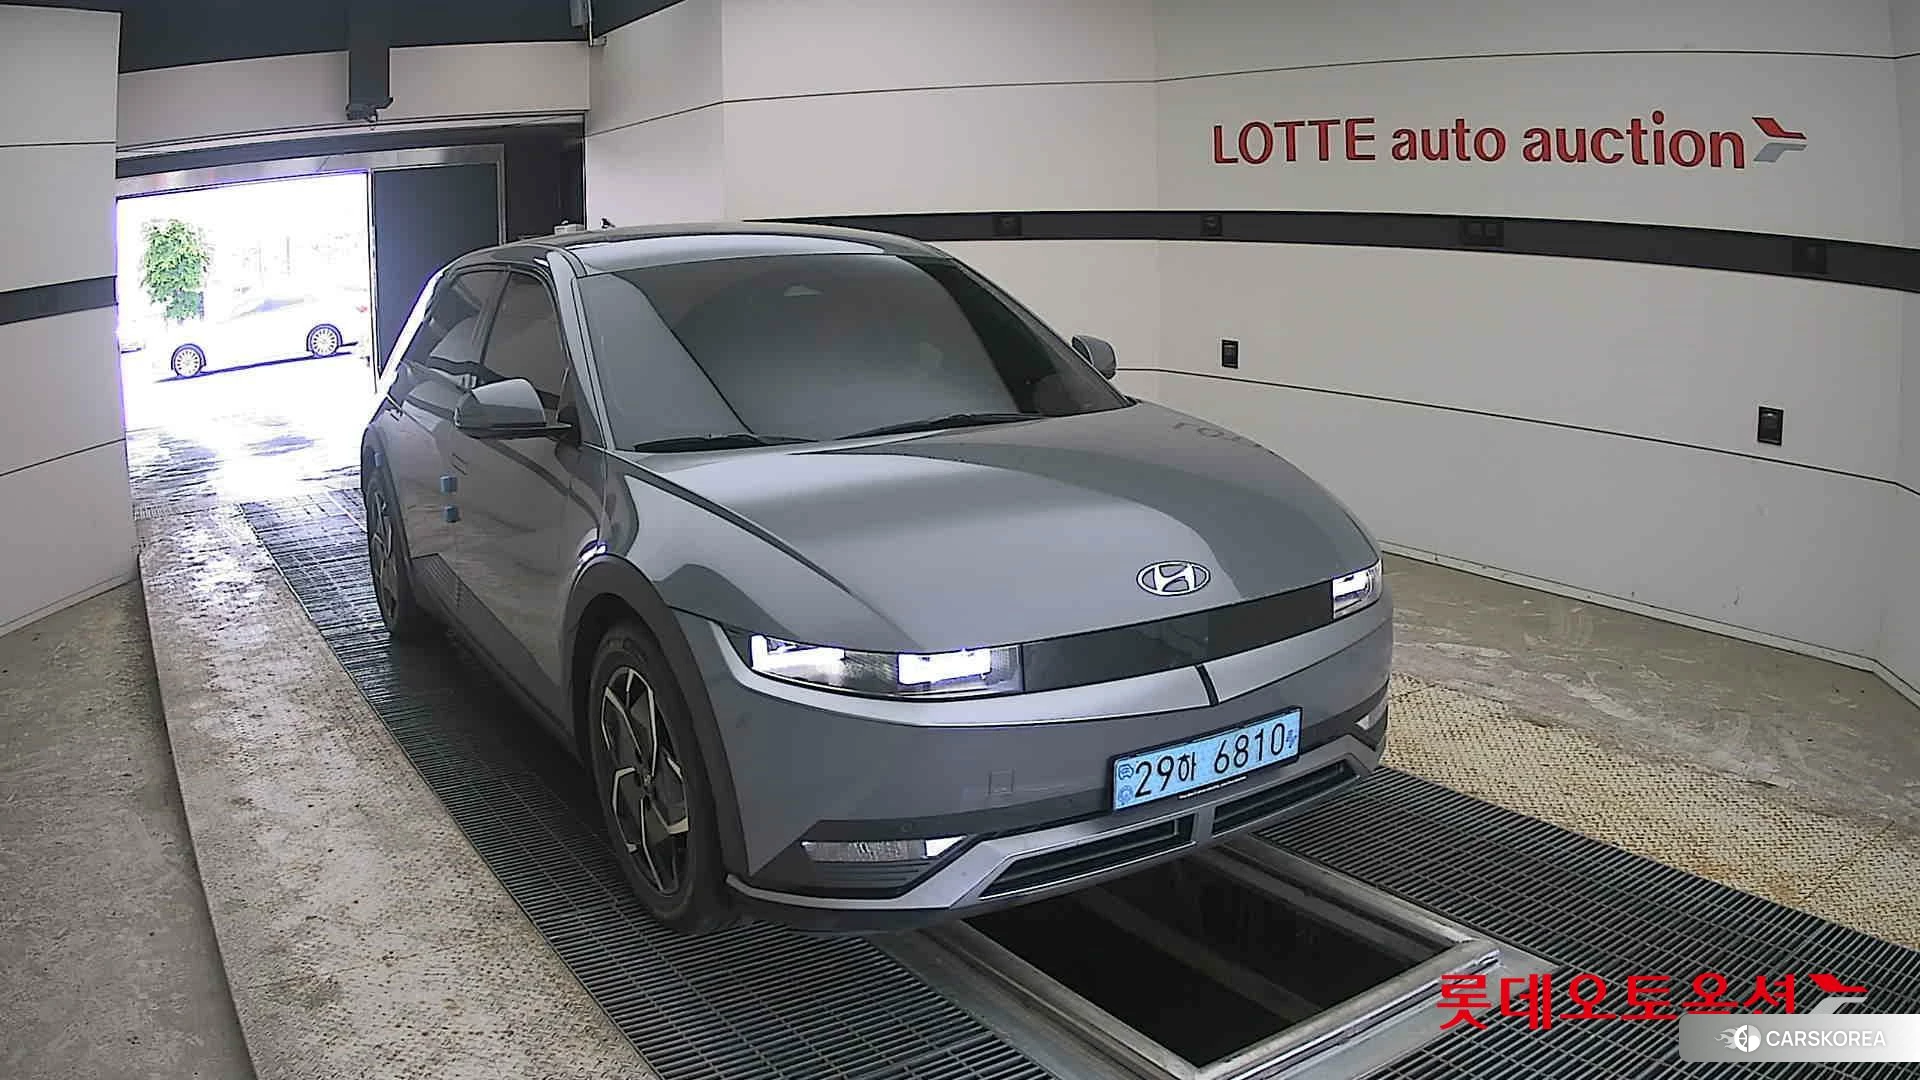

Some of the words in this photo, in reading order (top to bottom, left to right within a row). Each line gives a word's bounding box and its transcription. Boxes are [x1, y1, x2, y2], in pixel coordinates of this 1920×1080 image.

[1212, 117, 1377, 165] LOTTE
[1391, 118, 1507, 162] auto
[1522, 110, 1745, 170] auction
[1134, 751, 1198, 798] 29하
[1213, 722, 1287, 775] 6810
